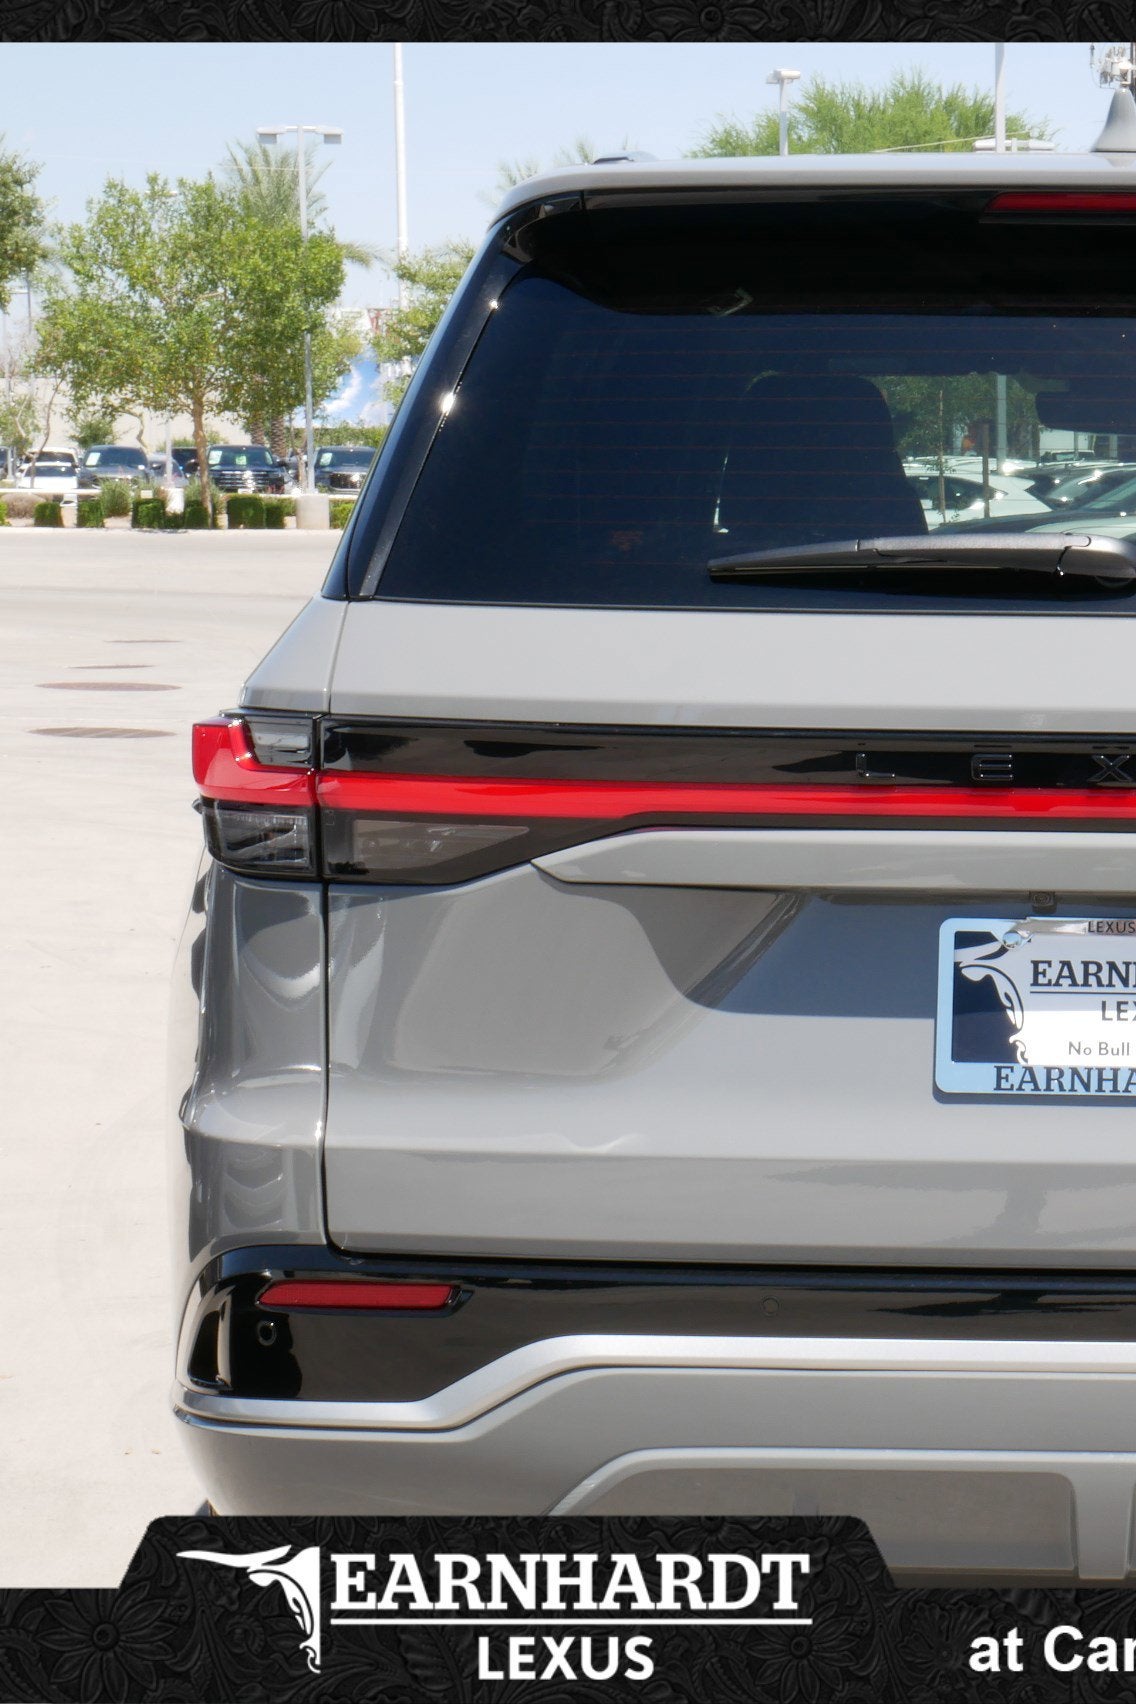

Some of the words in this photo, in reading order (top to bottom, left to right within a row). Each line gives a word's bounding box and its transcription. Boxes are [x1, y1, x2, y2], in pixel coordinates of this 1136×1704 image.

[1087, 920, 1136, 934] LEXUS
[1068, 1040, 1092, 1056] No
[1098, 1041, 1130, 1057] Bull
